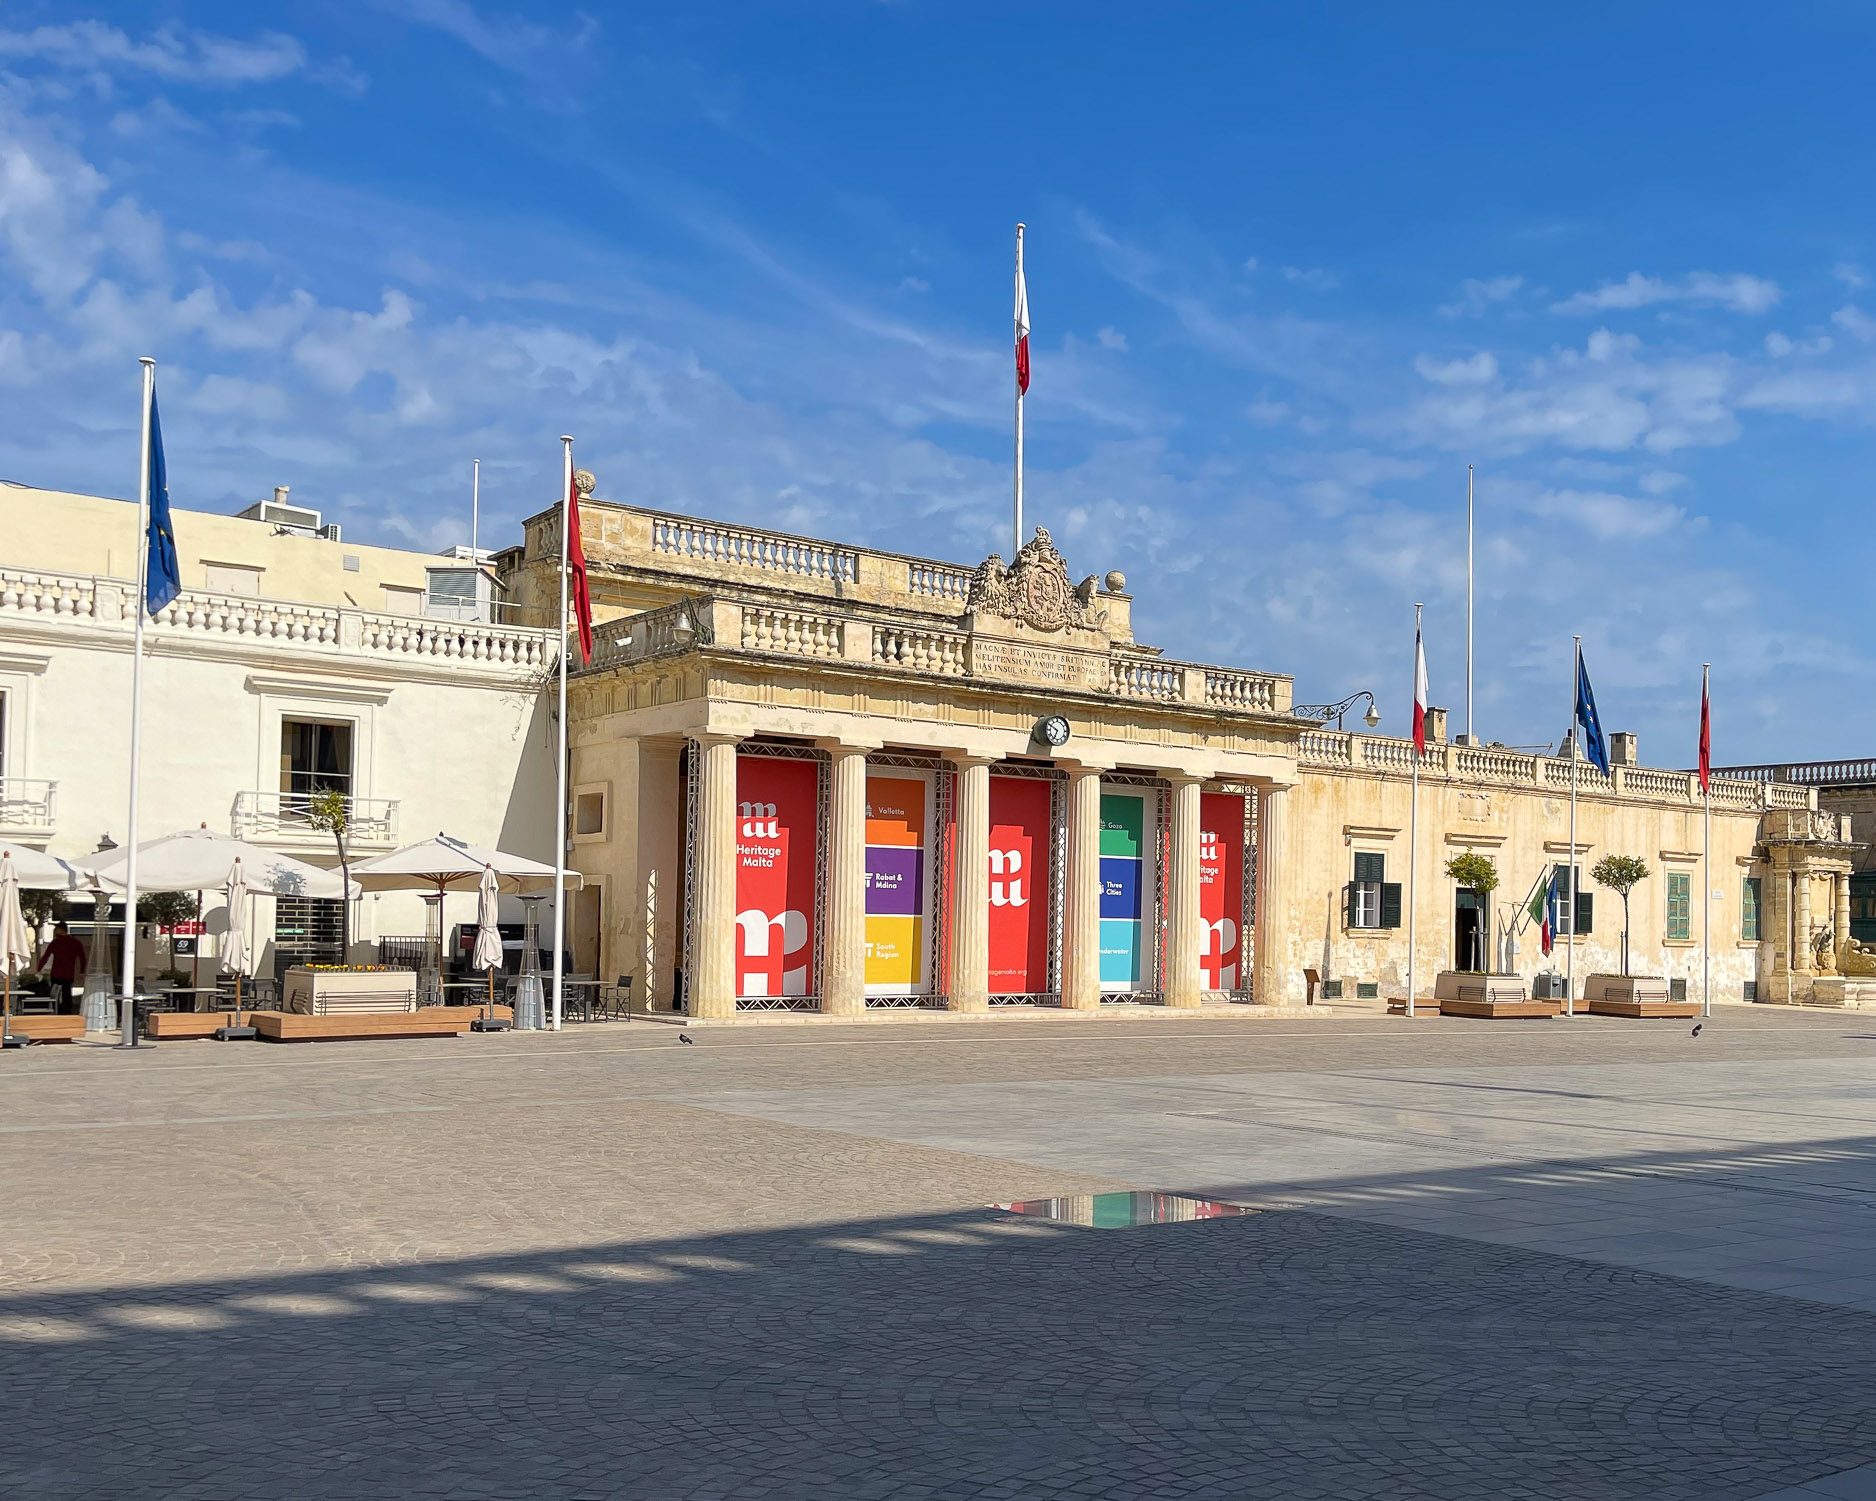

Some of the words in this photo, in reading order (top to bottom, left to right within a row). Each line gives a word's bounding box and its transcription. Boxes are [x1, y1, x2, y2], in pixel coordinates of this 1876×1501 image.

[1010, 648, 1021, 656] ET
[975, 662, 992, 671] HAS
[994, 664, 1028, 675] INSULAS
[1031, 669, 1077, 681] CONFIRMAT
[1057, 663, 1066, 672] ET
[878, 806, 905, 815] Valletta
[736, 844, 782, 858] Heritage
[742, 857, 773, 868] Malta
[1200, 864, 1219, 877] itage
[875, 872, 896, 881] Rabat
[896, 873, 903, 881] &
[1200, 875, 1214, 884] alta
[875, 881, 898, 889] Mdina
[1106, 880, 1123, 889] Three
[1106, 888, 1122, 896] Cities
[177, 939, 189, 949] 59
[876, 942, 896, 950] South
[876, 950, 900, 960] Region
[1099, 947, 1129, 955] nderwater
